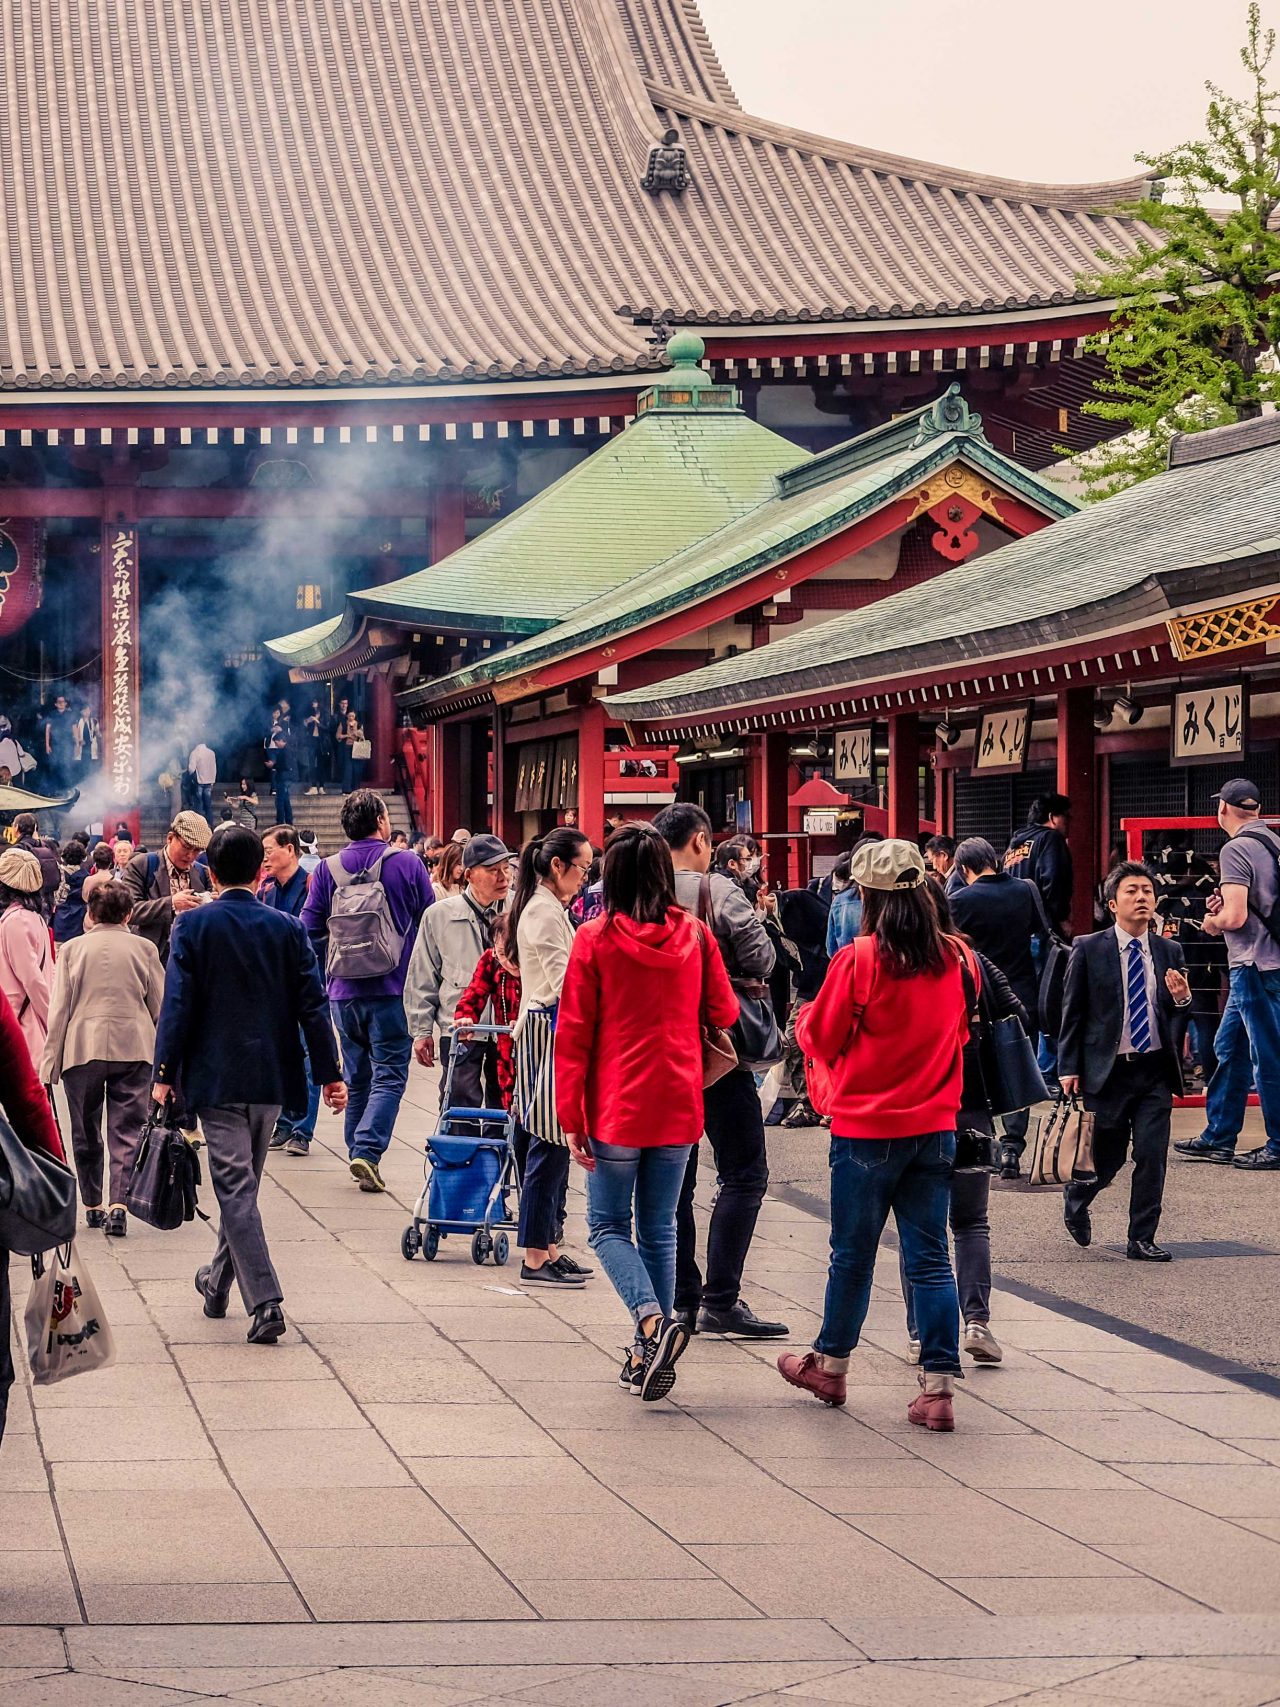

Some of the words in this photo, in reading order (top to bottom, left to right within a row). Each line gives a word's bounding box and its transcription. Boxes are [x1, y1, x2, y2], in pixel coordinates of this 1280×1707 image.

[1183, 694, 1240, 746] みくじ
[839, 735, 870, 771] みくじ
